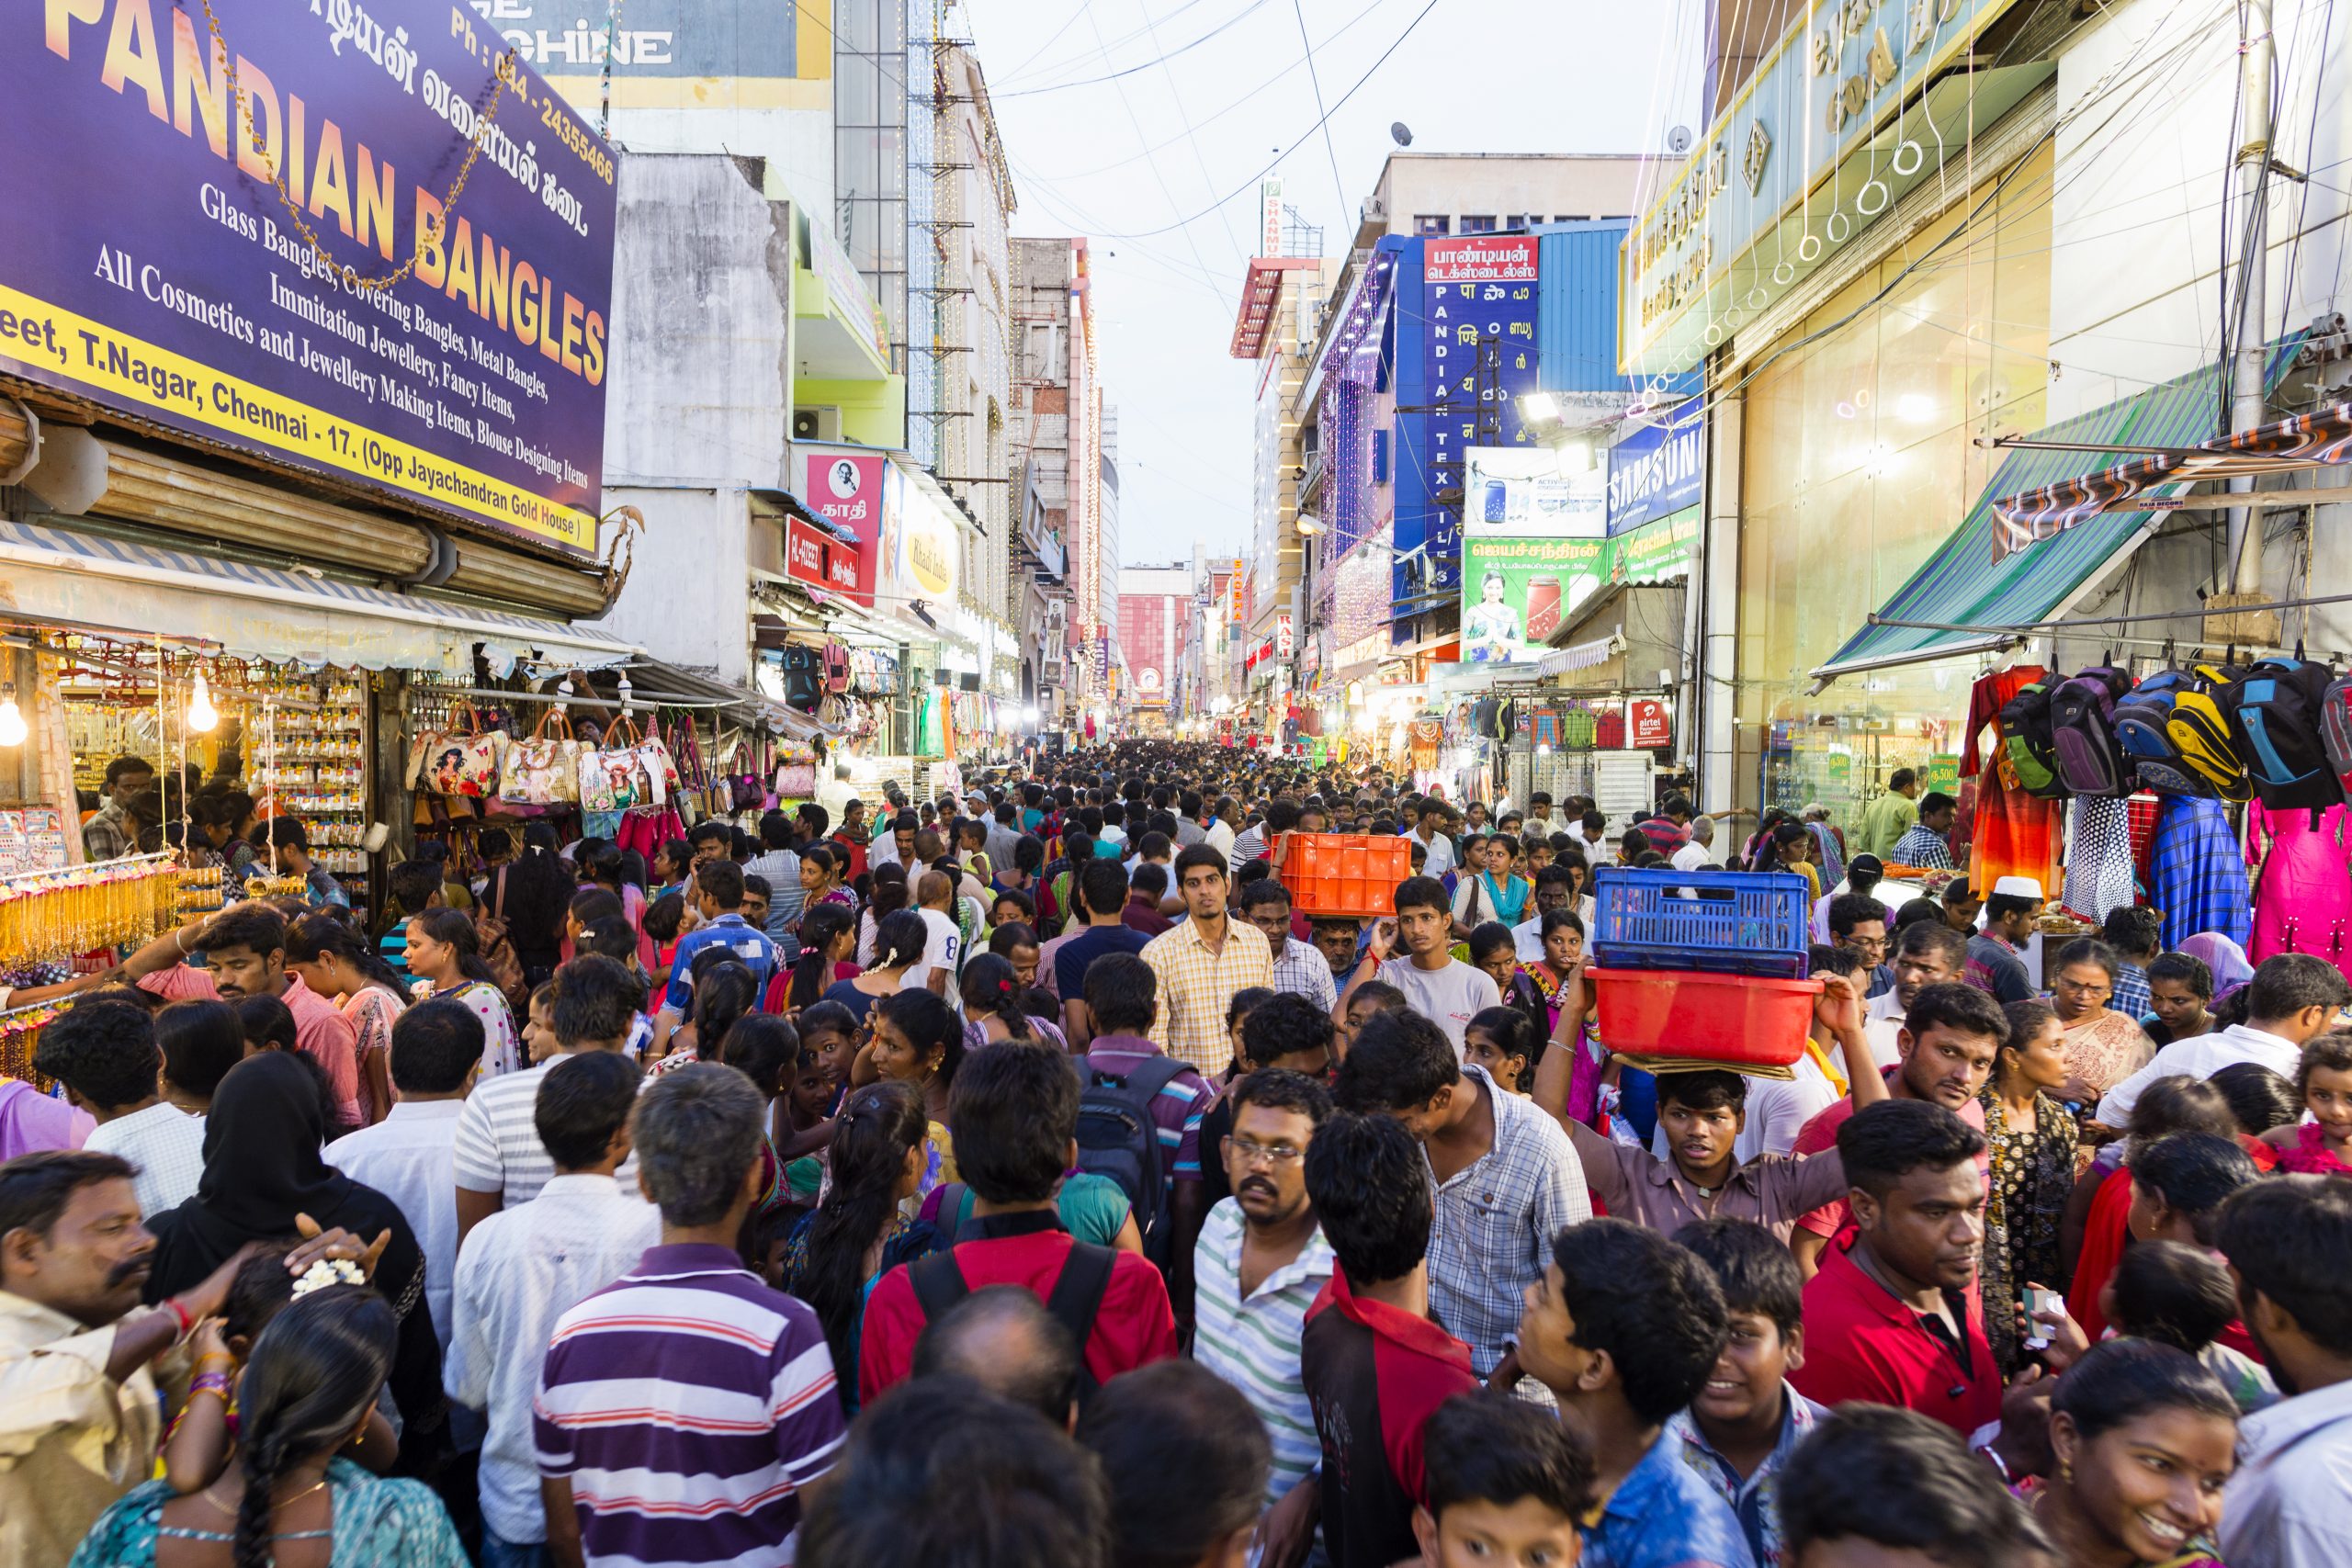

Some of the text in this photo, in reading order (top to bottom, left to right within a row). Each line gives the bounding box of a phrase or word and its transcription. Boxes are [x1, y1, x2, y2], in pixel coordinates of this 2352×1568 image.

[541, 97, 614, 185] 24355466
[542, 172, 588, 237] கடை
[1266, 199, 1279, 257] SHANMU
[1428, 263, 1536, 279] டெக்ஸ்டைல்ஸ்
[1434, 243, 1530, 265] பாண்டியன்
[200, 183, 548, 405] Glass Bangles, Covering Bangles, Metal Bangles,
[415, 186, 605, 387] BANGLES
[94, 243, 588, 490] All Cosmetics and Jewellery Making Items, Blouse Designing Items
[270, 272, 515, 424] Immitation Jewellery, Fancy Items,
[78, 329, 203, 412] T.Nagar,
[211, 382, 308, 442] Chennai
[327, 425, 357, 458] 17.
[362, 437, 402, 479] (Opp
[408, 456, 507, 510] Jayachandran
[512, 494, 537, 522] Gold
[541, 505, 574, 533] House
[821, 500, 866, 522] காதி
[1435, 434, 1448, 582] TEXILES
[791, 532, 819, 571] AL-AZEEZ
[913, 537, 932, 574] Khadi
[1627, 519, 1696, 558] Jeyachandran
[1279, 615, 1292, 657] RASI
[1639, 717, 1661, 727] airtel
[945, 936, 958, 960] 8
